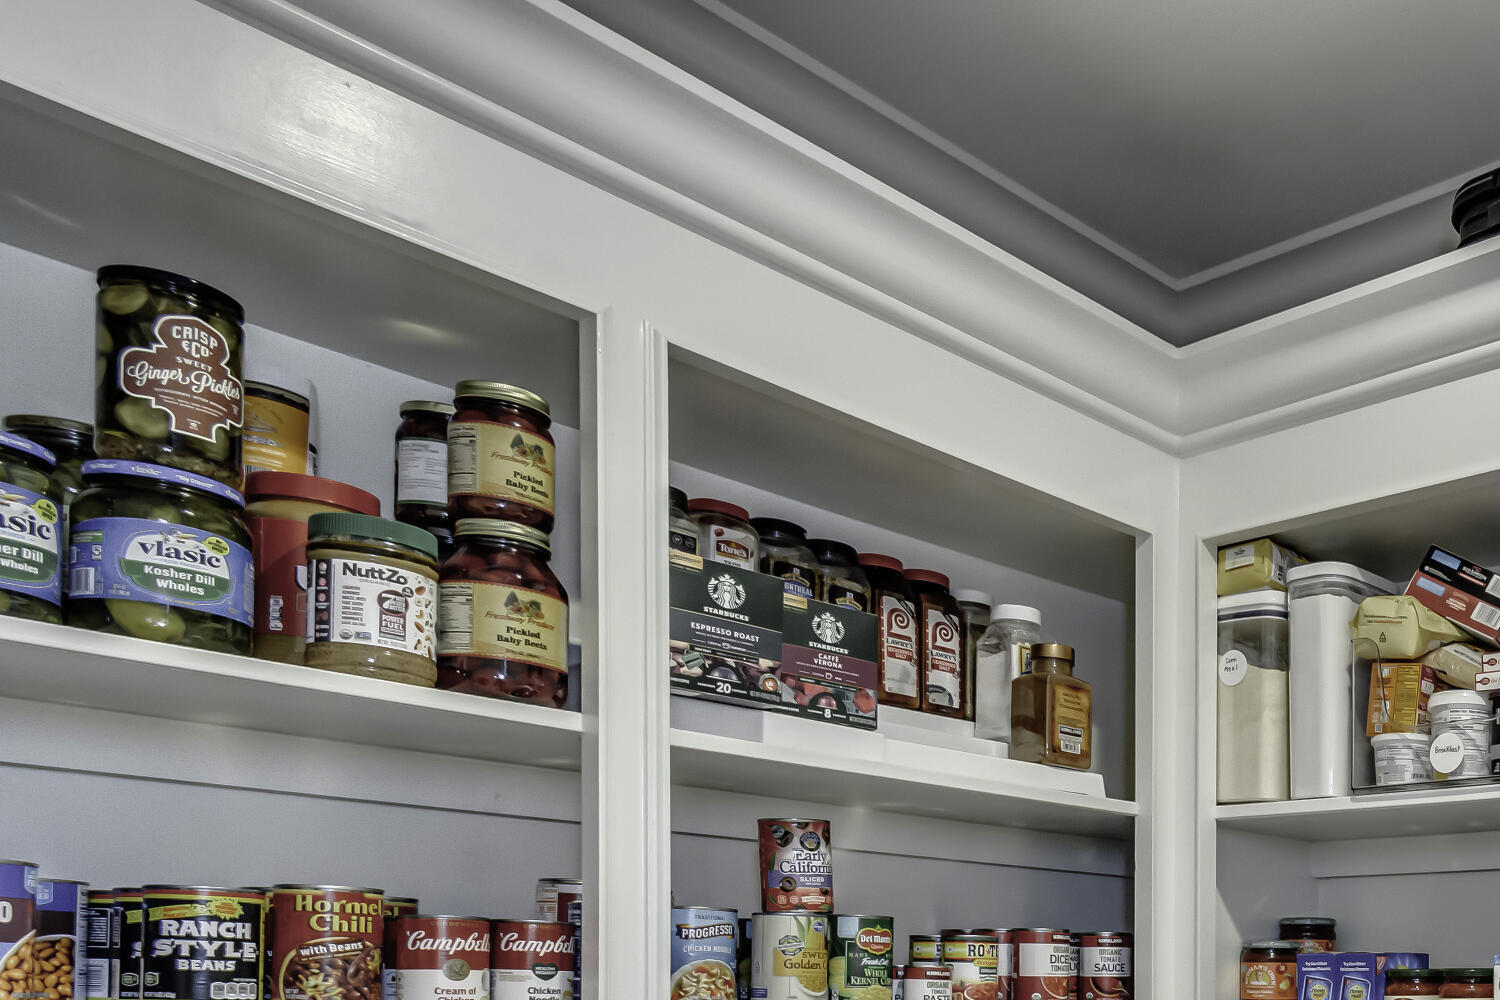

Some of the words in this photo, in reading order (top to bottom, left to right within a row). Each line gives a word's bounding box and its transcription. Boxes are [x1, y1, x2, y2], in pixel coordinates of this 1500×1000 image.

[172, 325, 218, 349] CRISP
[176, 356, 212, 372] SWEET
[127, 361, 190, 387] Ginger
[190, 371, 240, 400] Pickles
[505, 479, 529, 493] Baby
[513, 471, 543, 487] Pickled
[22, 548, 43, 563] Dill
[138, 541, 221, 568] vlasic
[143, 564, 192, 580] Kosher
[195, 572, 215, 586] Dill
[342, 562, 408, 586] NuttZo
[156, 578, 205, 596] Wholes
[703, 606, 749, 621] STARBUCKS
[506, 626, 540, 639] Pickled
[691, 621, 732, 636] ESPRESSO
[734, 632, 760, 643] ROAST
[497, 634, 522, 648] Baby
[524, 638, 548, 651] Beets
[809, 641, 848, 655] STARBUCKS
[886, 638, 914, 649] LAWRY'S
[813, 658, 842, 670] VERONA
[818, 652, 840, 661] CAFFÈ
[716, 682, 732, 694] 20
[824, 708, 832, 718] 8
[795, 850, 827, 864] Early
[295, 894, 383, 914] Hormel
[159, 920, 251, 940] RANCH
[309, 914, 372, 933] Chili
[682, 925, 733, 940] PROGRESSO
[152, 939, 257, 963] STYLE
[300, 944, 326, 957] with
[328, 940, 363, 954] Beans
[683, 945, 711, 953] CHICKEN
[175, 958, 236, 973] BEANS
[784, 959, 823, 971] Golden
[1094, 963, 1126, 973] SAUCE
[865, 969, 888, 977] WHOLE
[851, 977, 881, 986] KERNEL
[434, 987, 466, 996] Cream
[469, 986, 477, 996] of
[527, 987, 561, 996] Chicken
